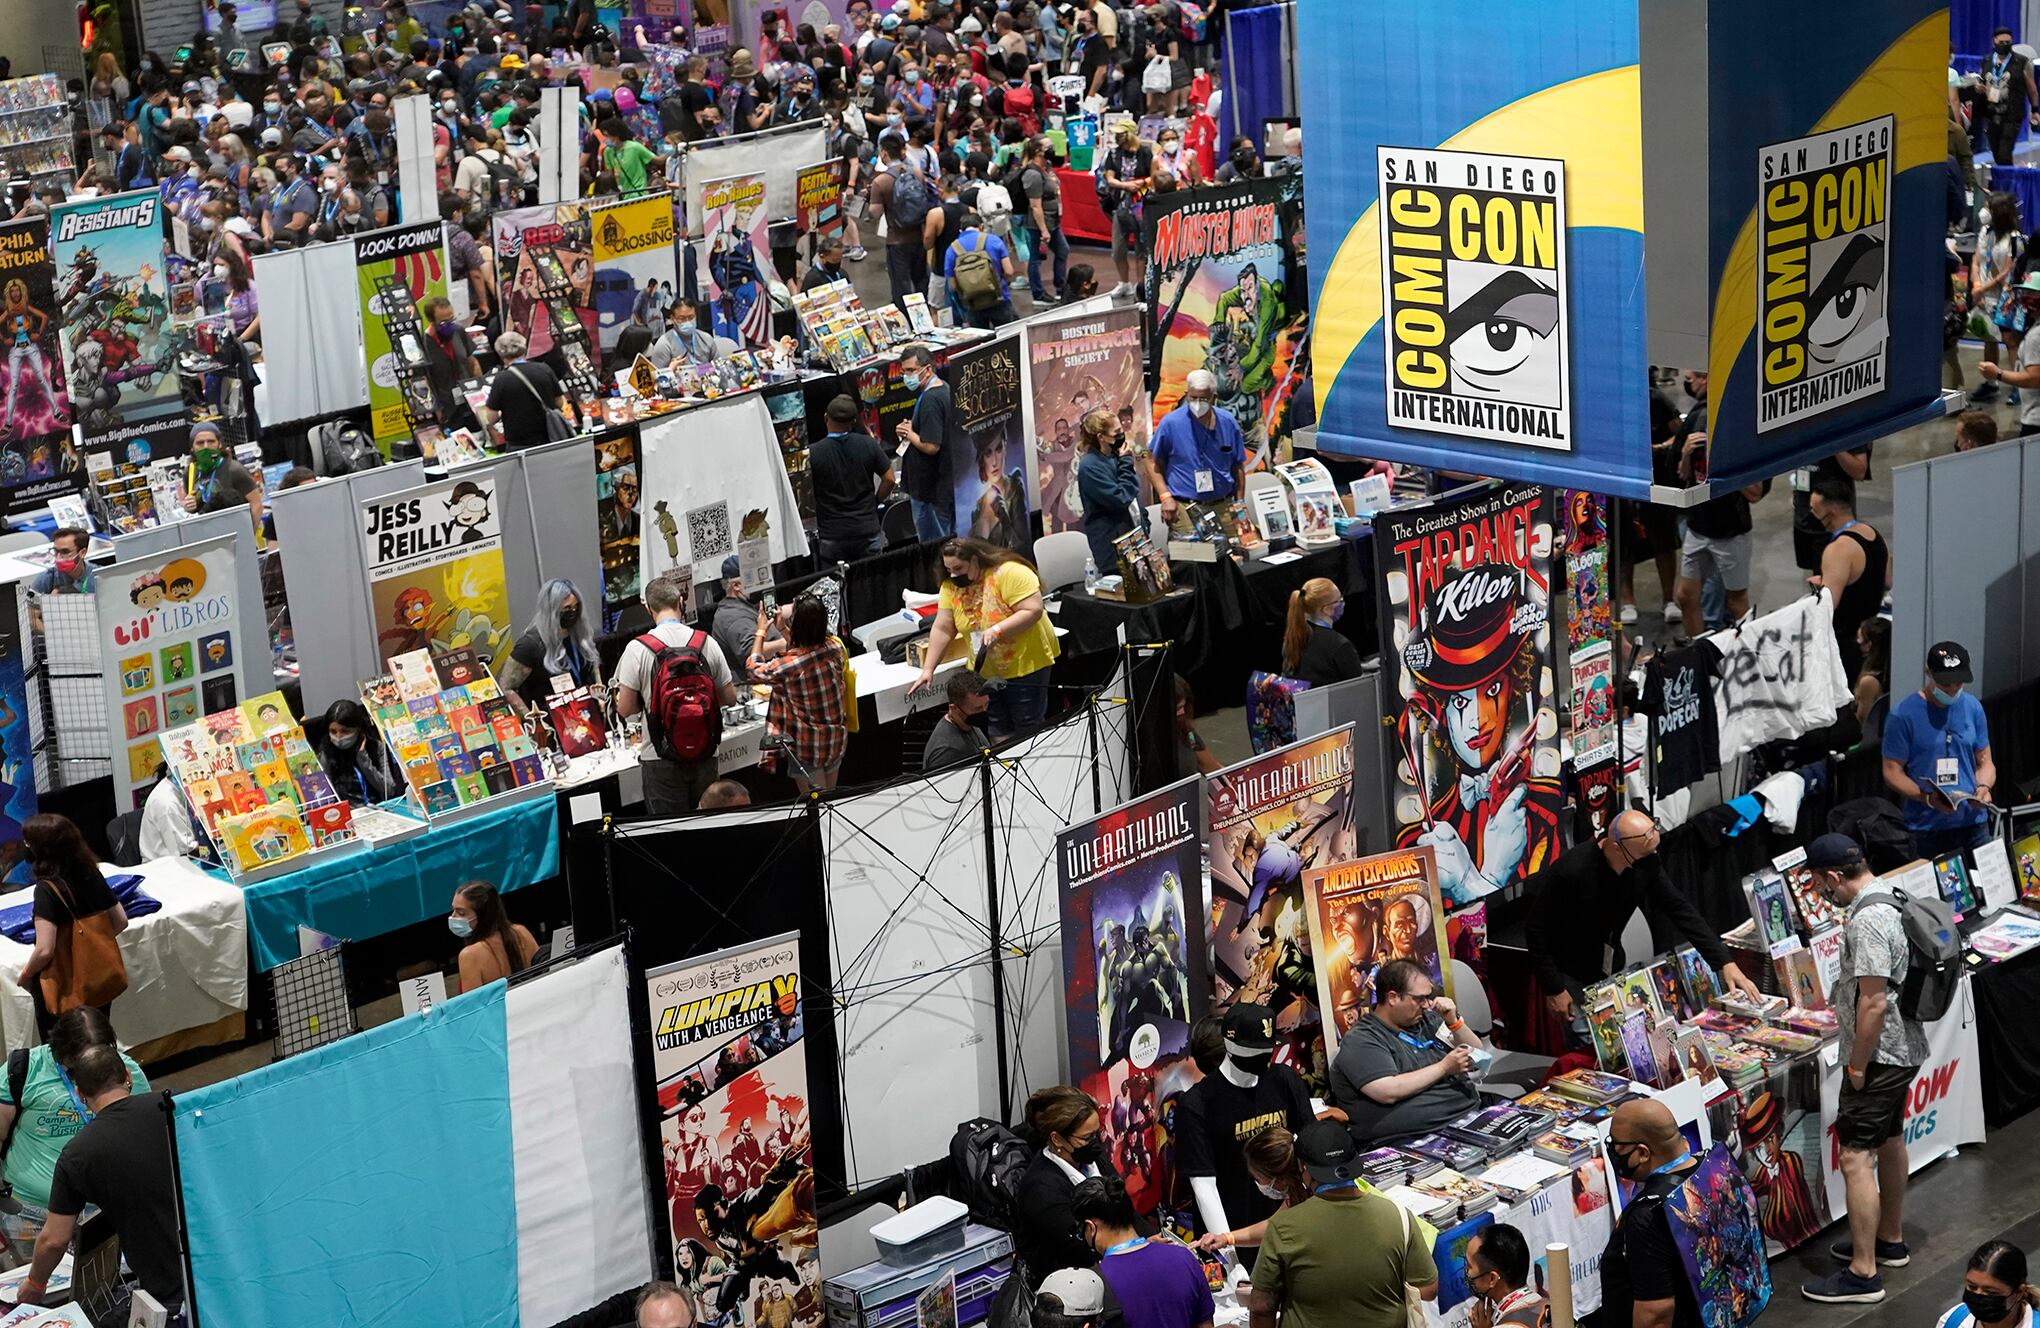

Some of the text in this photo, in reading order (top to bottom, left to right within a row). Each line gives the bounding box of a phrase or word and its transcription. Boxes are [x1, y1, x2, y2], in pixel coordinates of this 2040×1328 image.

[1765, 126, 1888, 180] SAN DIEGO
[801, 172, 828, 192] DEATH
[1385, 157, 1556, 194] SAN DIEGO
[58, 199, 155, 242] RESISTANTS
[1183, 194, 1254, 214] BIFF STONE
[1813, 158, 1885, 241] CON
[358, 227, 441, 258] LOOK DOWN!
[522, 223, 565, 248] RED
[615, 227, 673, 253] CROSSING
[1154, 202, 1275, 273] MONSTER HUNTER
[1448, 193, 1555, 269] CON
[1390, 189, 1448, 390] COMIC
[1765, 180, 1808, 386] COMIC
[1032, 328, 1141, 364] METAPHYSICAL
[1061, 322, 1105, 340] BOSTON
[1064, 349, 1110, 368] SOCIETY
[1762, 359, 1881, 423] INTERNATIONAL
[85, 417, 187, 447] www.BigBlueComics.com
[1394, 391, 1564, 440] INTERNATIONAL
[367, 499, 422, 535] JESS
[1392, 524, 1413, 540] The
[1416, 512, 1458, 534] Greatest
[1460, 503, 1488, 521] Show
[1490, 497, 1500, 511] in
[375, 541, 496, 577] COMICS ILLUSTRATIONS STORYBOARDS ANIMATICS
[378, 519, 457, 563] REILLY
[1394, 498, 1548, 633] TAP DANCE
[162, 595, 230, 633] LIBROS
[1436, 571, 1515, 625] Killer
[1237, 743, 1352, 812] UNEARTHIANS
[1576, 749, 1603, 766] SHIRTS
[1066, 802, 1191, 880] UNEARTHIANS
[1069, 833, 1195, 889] TheUnearthiansComics.com MorasProductions.com
[1322, 853, 1421, 895] ANCIENT EXPLORERS
[1327, 900, 1345, 908] The
[1346, 894, 1366, 905] Lost
[1367, 888, 1385, 901] City
[1387, 887, 1396, 896] of
[657, 979, 773, 1036] LUMPIA
[657, 1006, 774, 1050] WITH A VENGEANCE
[36, 1116, 66, 1126] Camp
